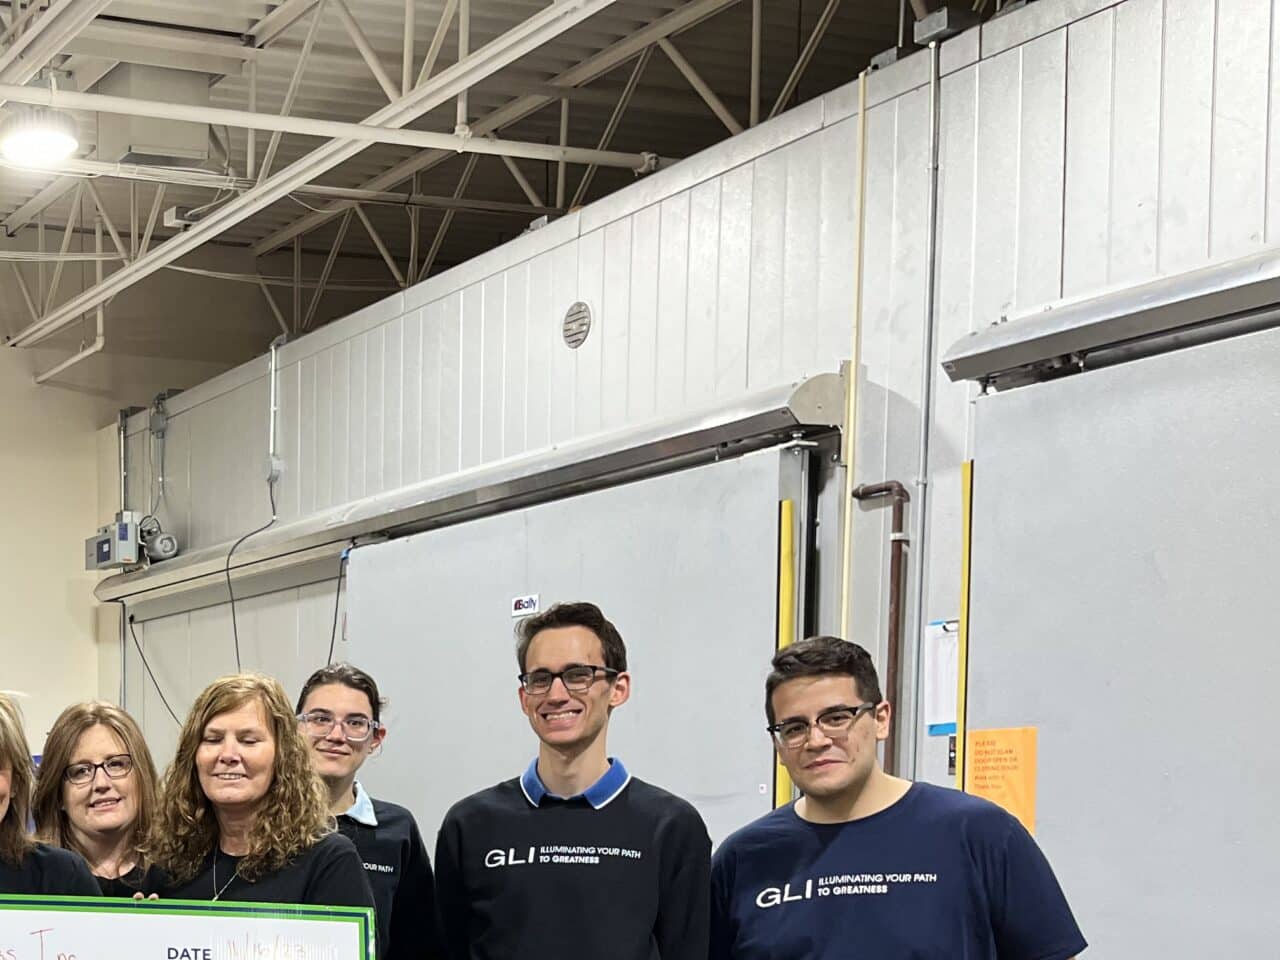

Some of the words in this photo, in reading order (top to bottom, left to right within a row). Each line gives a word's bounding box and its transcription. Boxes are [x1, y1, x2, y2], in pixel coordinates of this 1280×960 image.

[485, 847, 535, 868] GLI
[540, 846, 596, 854] ILLUMINATING
[597, 847, 620, 856] YOUR
[621, 849, 641, 859] PATH
[552, 856, 600, 864] GREATNESS
[756, 879, 813, 908] GLI
[818, 873, 883, 886] ILLUMINATING
[885, 873, 911, 883] YOUR
[913, 873, 937, 883] PATH
[817, 887, 830, 896] TO
[833, 885, 888, 895] GREATNESS
[167, 947, 212, 960] DATE
